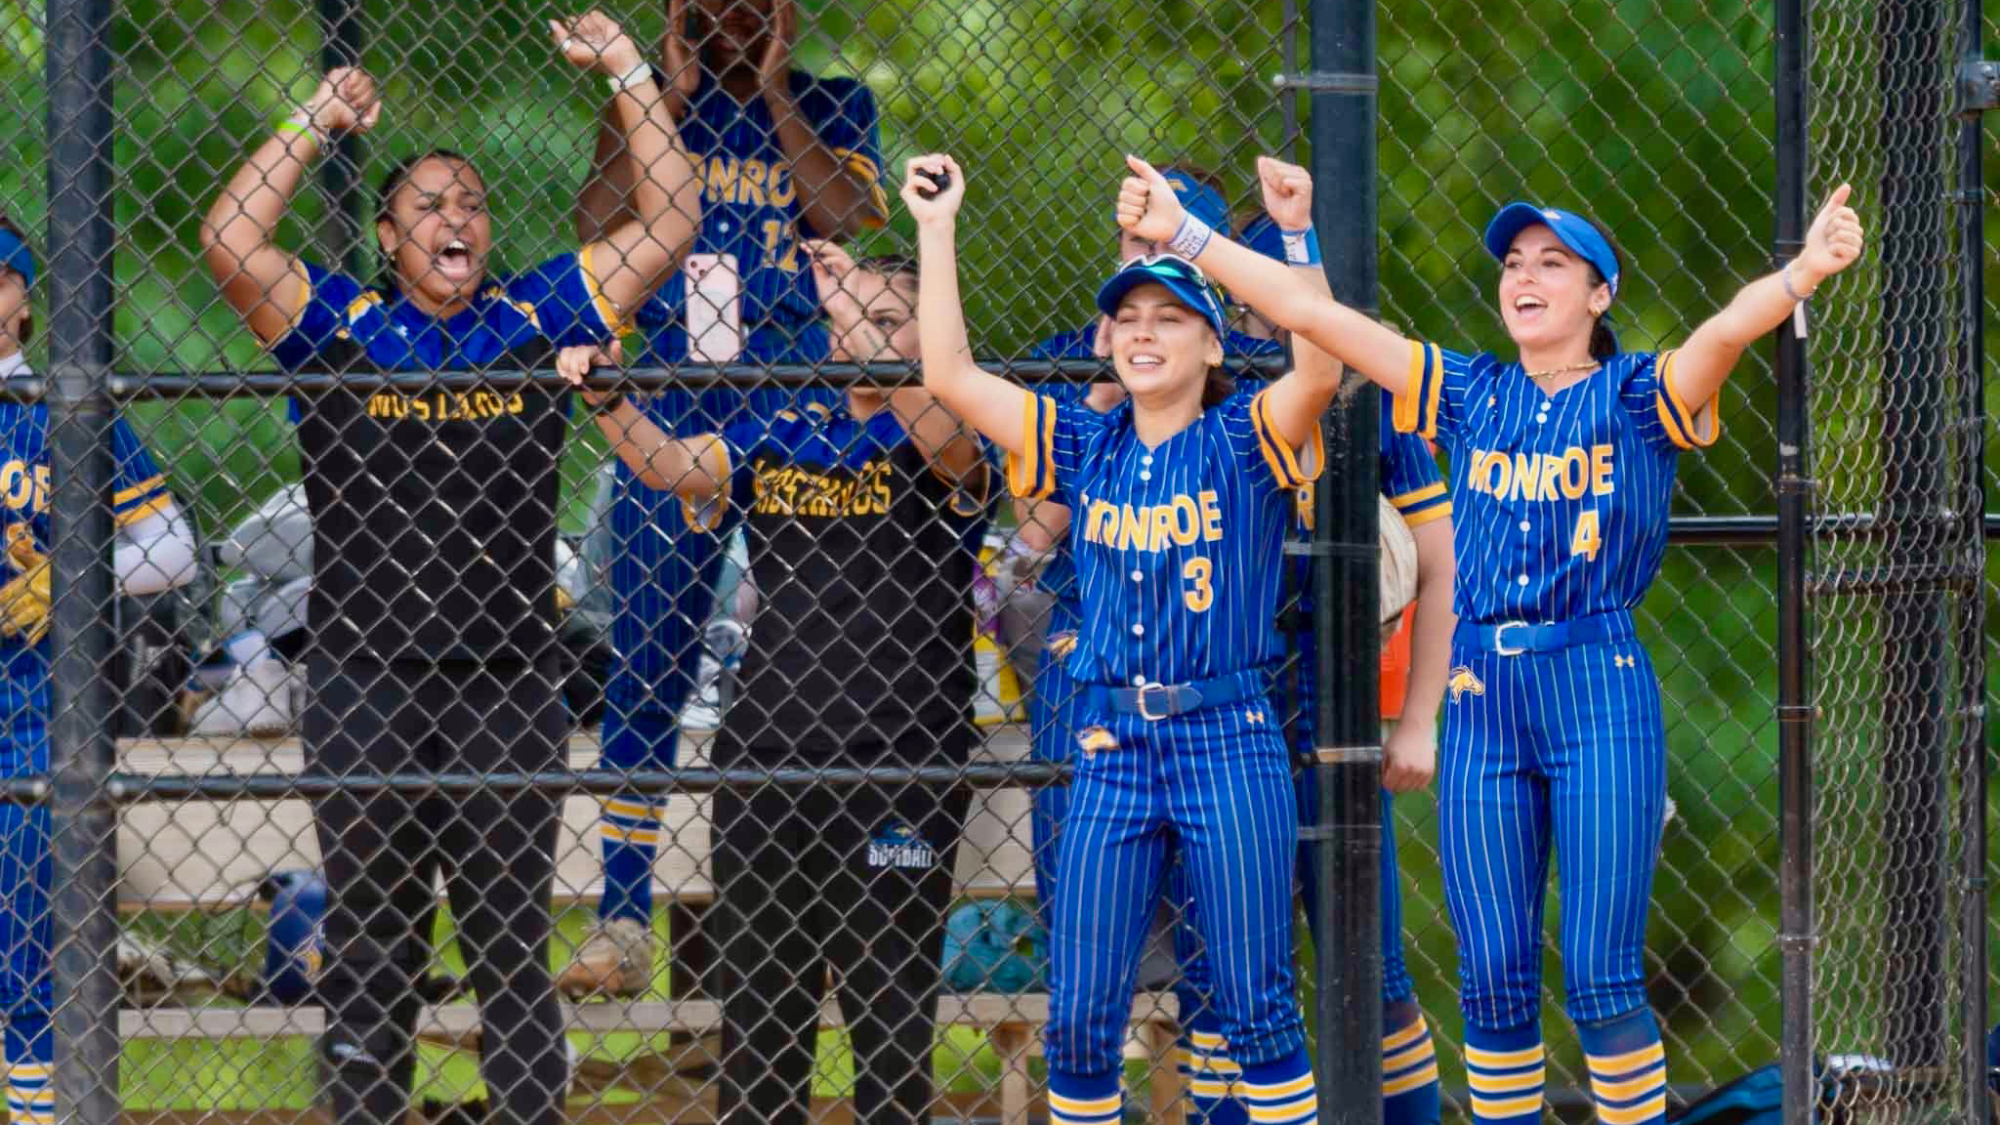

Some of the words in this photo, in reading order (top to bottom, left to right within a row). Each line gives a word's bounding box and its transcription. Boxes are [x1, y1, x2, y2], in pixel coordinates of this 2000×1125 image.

[1468, 444, 1615, 503] MONROE
[1081, 490, 1223, 553] MONROE
[1571, 510, 1602, 562] 4
[1183, 556, 1214, 613] 3
